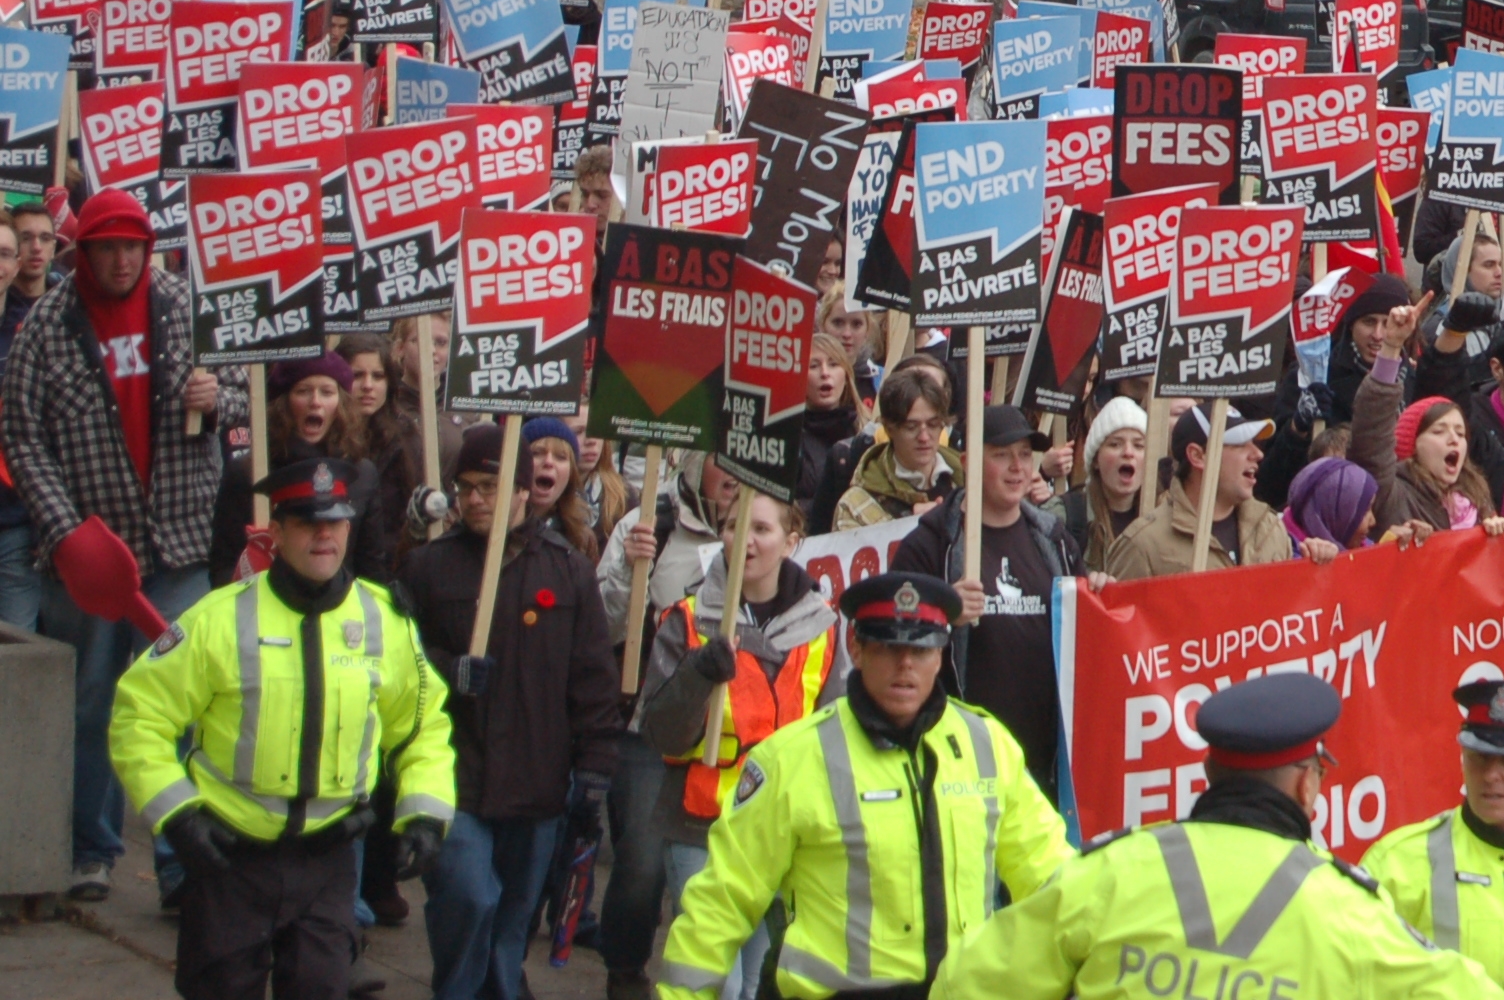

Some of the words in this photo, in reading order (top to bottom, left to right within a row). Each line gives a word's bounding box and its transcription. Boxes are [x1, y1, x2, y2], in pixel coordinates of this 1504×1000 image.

[175, 11, 282, 51] DROP
[367, 5, 384, 18] LA
[1337, 1, 1397, 31] DROP
[996, 30, 1053, 62] END
[1097, 26, 1143, 55] DROP
[1217, 47, 1298, 76] DROP
[178, 42, 279, 87] FEES!
[479, 53, 569, 103] PAUVRETÉ
[1000, 45, 1076, 81] POVERTY
[1097, 52, 1142, 78] FEES!
[245, 74, 352, 118] DROP
[1126, 73, 1233, 119] DROP
[1267, 83, 1367, 128] DROP
[250, 108, 354, 152] FEES!
[559, 138, 580, 150] LES
[1126, 122, 1231, 166] FEES
[1271, 113, 1369, 157] FEES!
[1438, 144, 1451, 160] À
[1454, 147, 1484, 160] BAS
[354, 130, 467, 190] DROP
[661, 152, 750, 200] DROP
[921, 141, 1006, 186] END
[1452, 161, 1473, 173] LA
[194, 181, 310, 234] DROP
[361, 165, 474, 224] FEES!
[661, 185, 747, 229] FEES!
[925, 166, 1038, 214] POVERTY
[1302, 194, 1362, 225] RAIS!
[202, 213, 316, 268] FEES!
[467, 226, 584, 271] DROP
[1182, 218, 1295, 266] DROP
[377, 261, 456, 305] FRAIS
[383, 256, 419, 278] LES
[470, 265, 584, 308] FEES!
[923, 259, 1037, 311] PAUVRETÉ
[1183, 254, 1292, 301] FEES!
[214, 306, 309, 350] FRAIS!
[1108, 314, 1119, 335] À
[1123, 304, 1159, 327] BAS
[733, 330, 802, 373] FEES!
[1178, 343, 1272, 382] FRAIS!
[1188, 339, 1224, 358] LES
[330, 653, 382, 670] POLICE
[1121, 644, 1173, 687] WE
[1180, 609, 1324, 674] SUPPORT
[1329, 603, 1345, 634] A
[940, 779, 996, 796] POLICE
[1115, 942, 1299, 1000] POLICE
